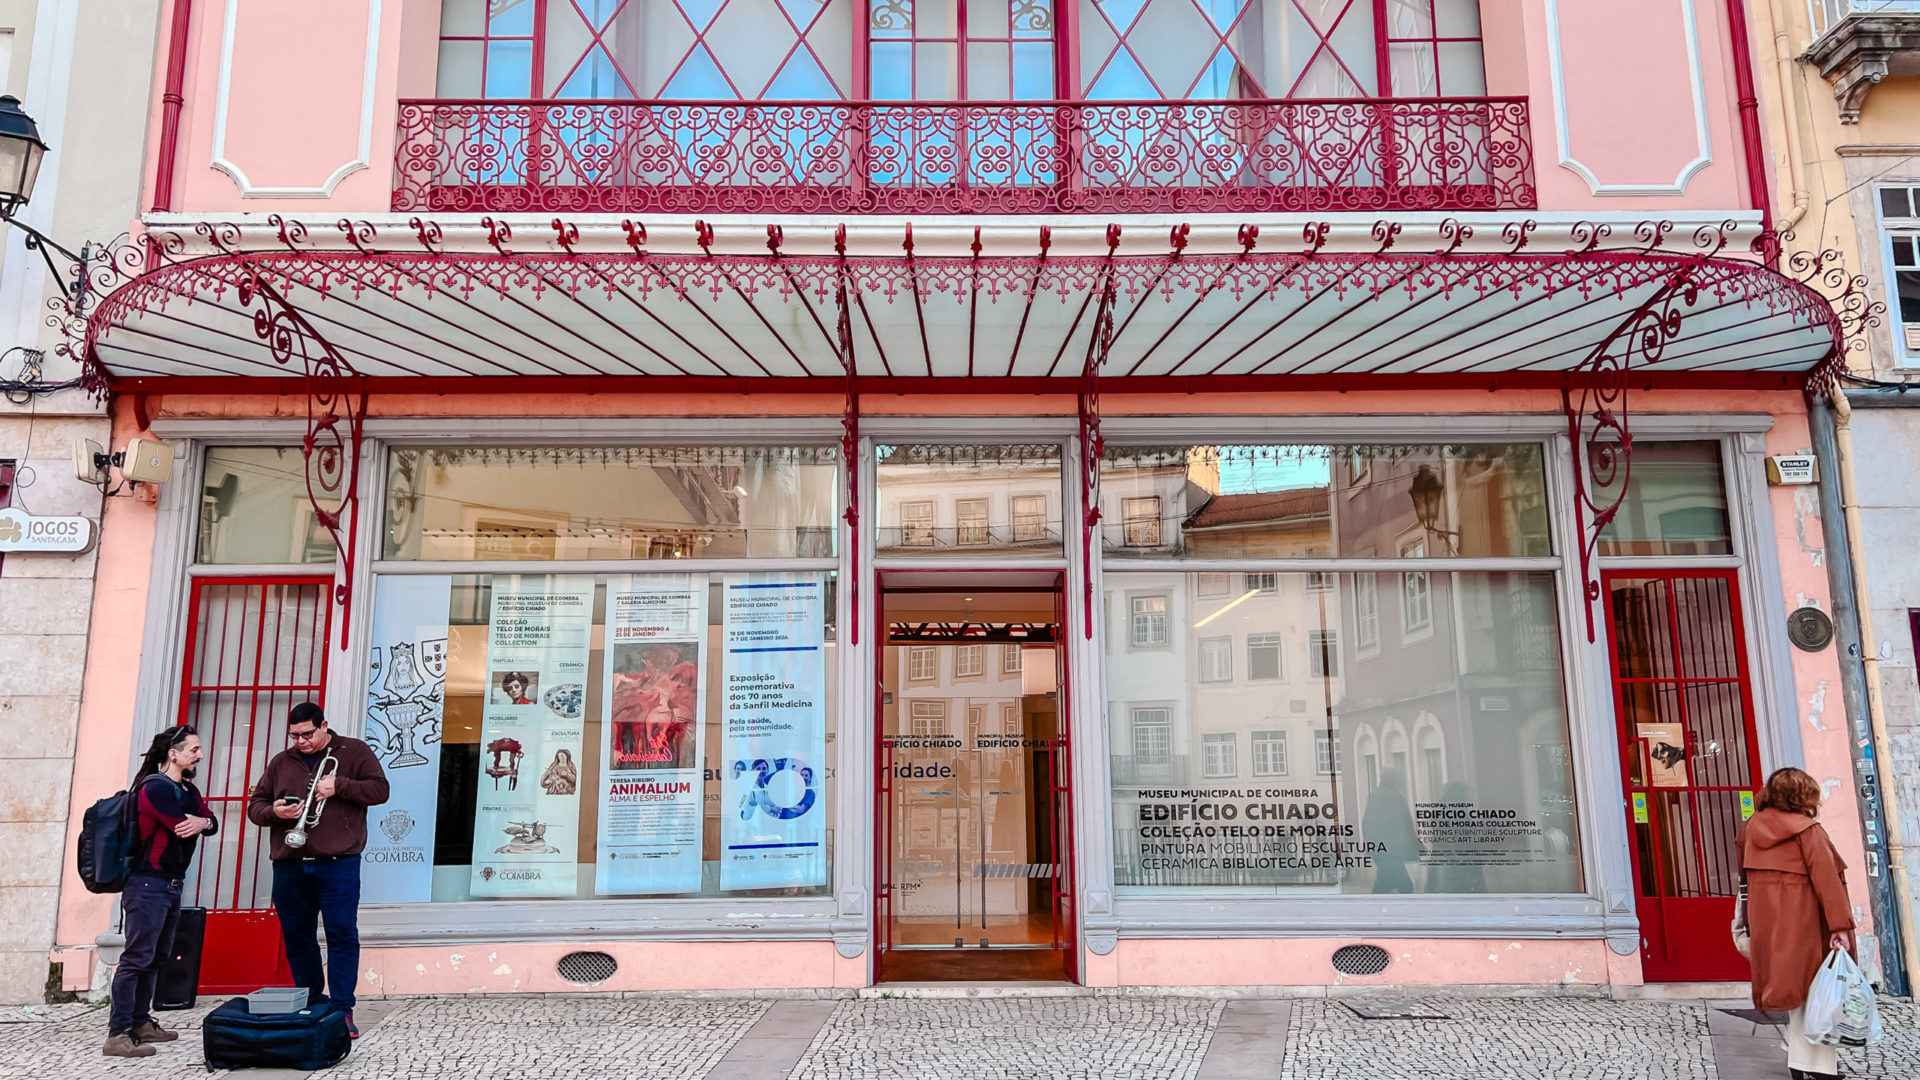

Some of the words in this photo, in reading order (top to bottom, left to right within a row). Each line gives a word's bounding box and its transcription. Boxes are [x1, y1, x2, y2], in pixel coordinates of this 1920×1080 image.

[26, 521, 78, 539] JOGOS
[496, 618, 528, 626] COLEÇÃO
[729, 673, 775, 683] Exposição
[729, 682, 795, 692] comemorativa
[743, 701, 770, 710] Sanfil
[771, 700, 812, 708] Medicina
[747, 717, 772, 725] saúde,
[729, 725, 745, 733] pela
[922, 740, 962, 748] CHIADO
[977, 738, 1019, 748] EDIFÍCIO
[609, 782, 691, 795] ANIMALIUM
[1138, 790, 1178, 798] MUSEU
[1181, 789, 1244, 798] MUNICIPAL
[1246, 789, 1262, 798] DE
[1265, 789, 1318, 798] COIMBRA
[640, 794, 675, 802] ESPELHO
[1140, 798, 1238, 820] EDIFÍCIO
[1245, 803, 1337, 820] CHIADO
[1416, 807, 1466, 819] EDIFÍCIO
[1469, 809, 1516, 818] CHIADO
[1140, 822, 1216, 842] COLEÇÃO
[1220, 825, 1260, 838] TELO
[1264, 825, 1286, 837] DE
[1290, 824, 1354, 837] MORAIS
[1141, 843, 1206, 854] PINTURA
[1302, 842, 1387, 853] ESCULTURA
[364, 852, 425, 863] COIMBRA
[1222, 857, 1308, 869] BIBLIOTECA
[1311, 857, 1331, 868] DE
[1334, 856, 1373, 868] ARTE
[499, 872, 542, 880] COIMBRA
